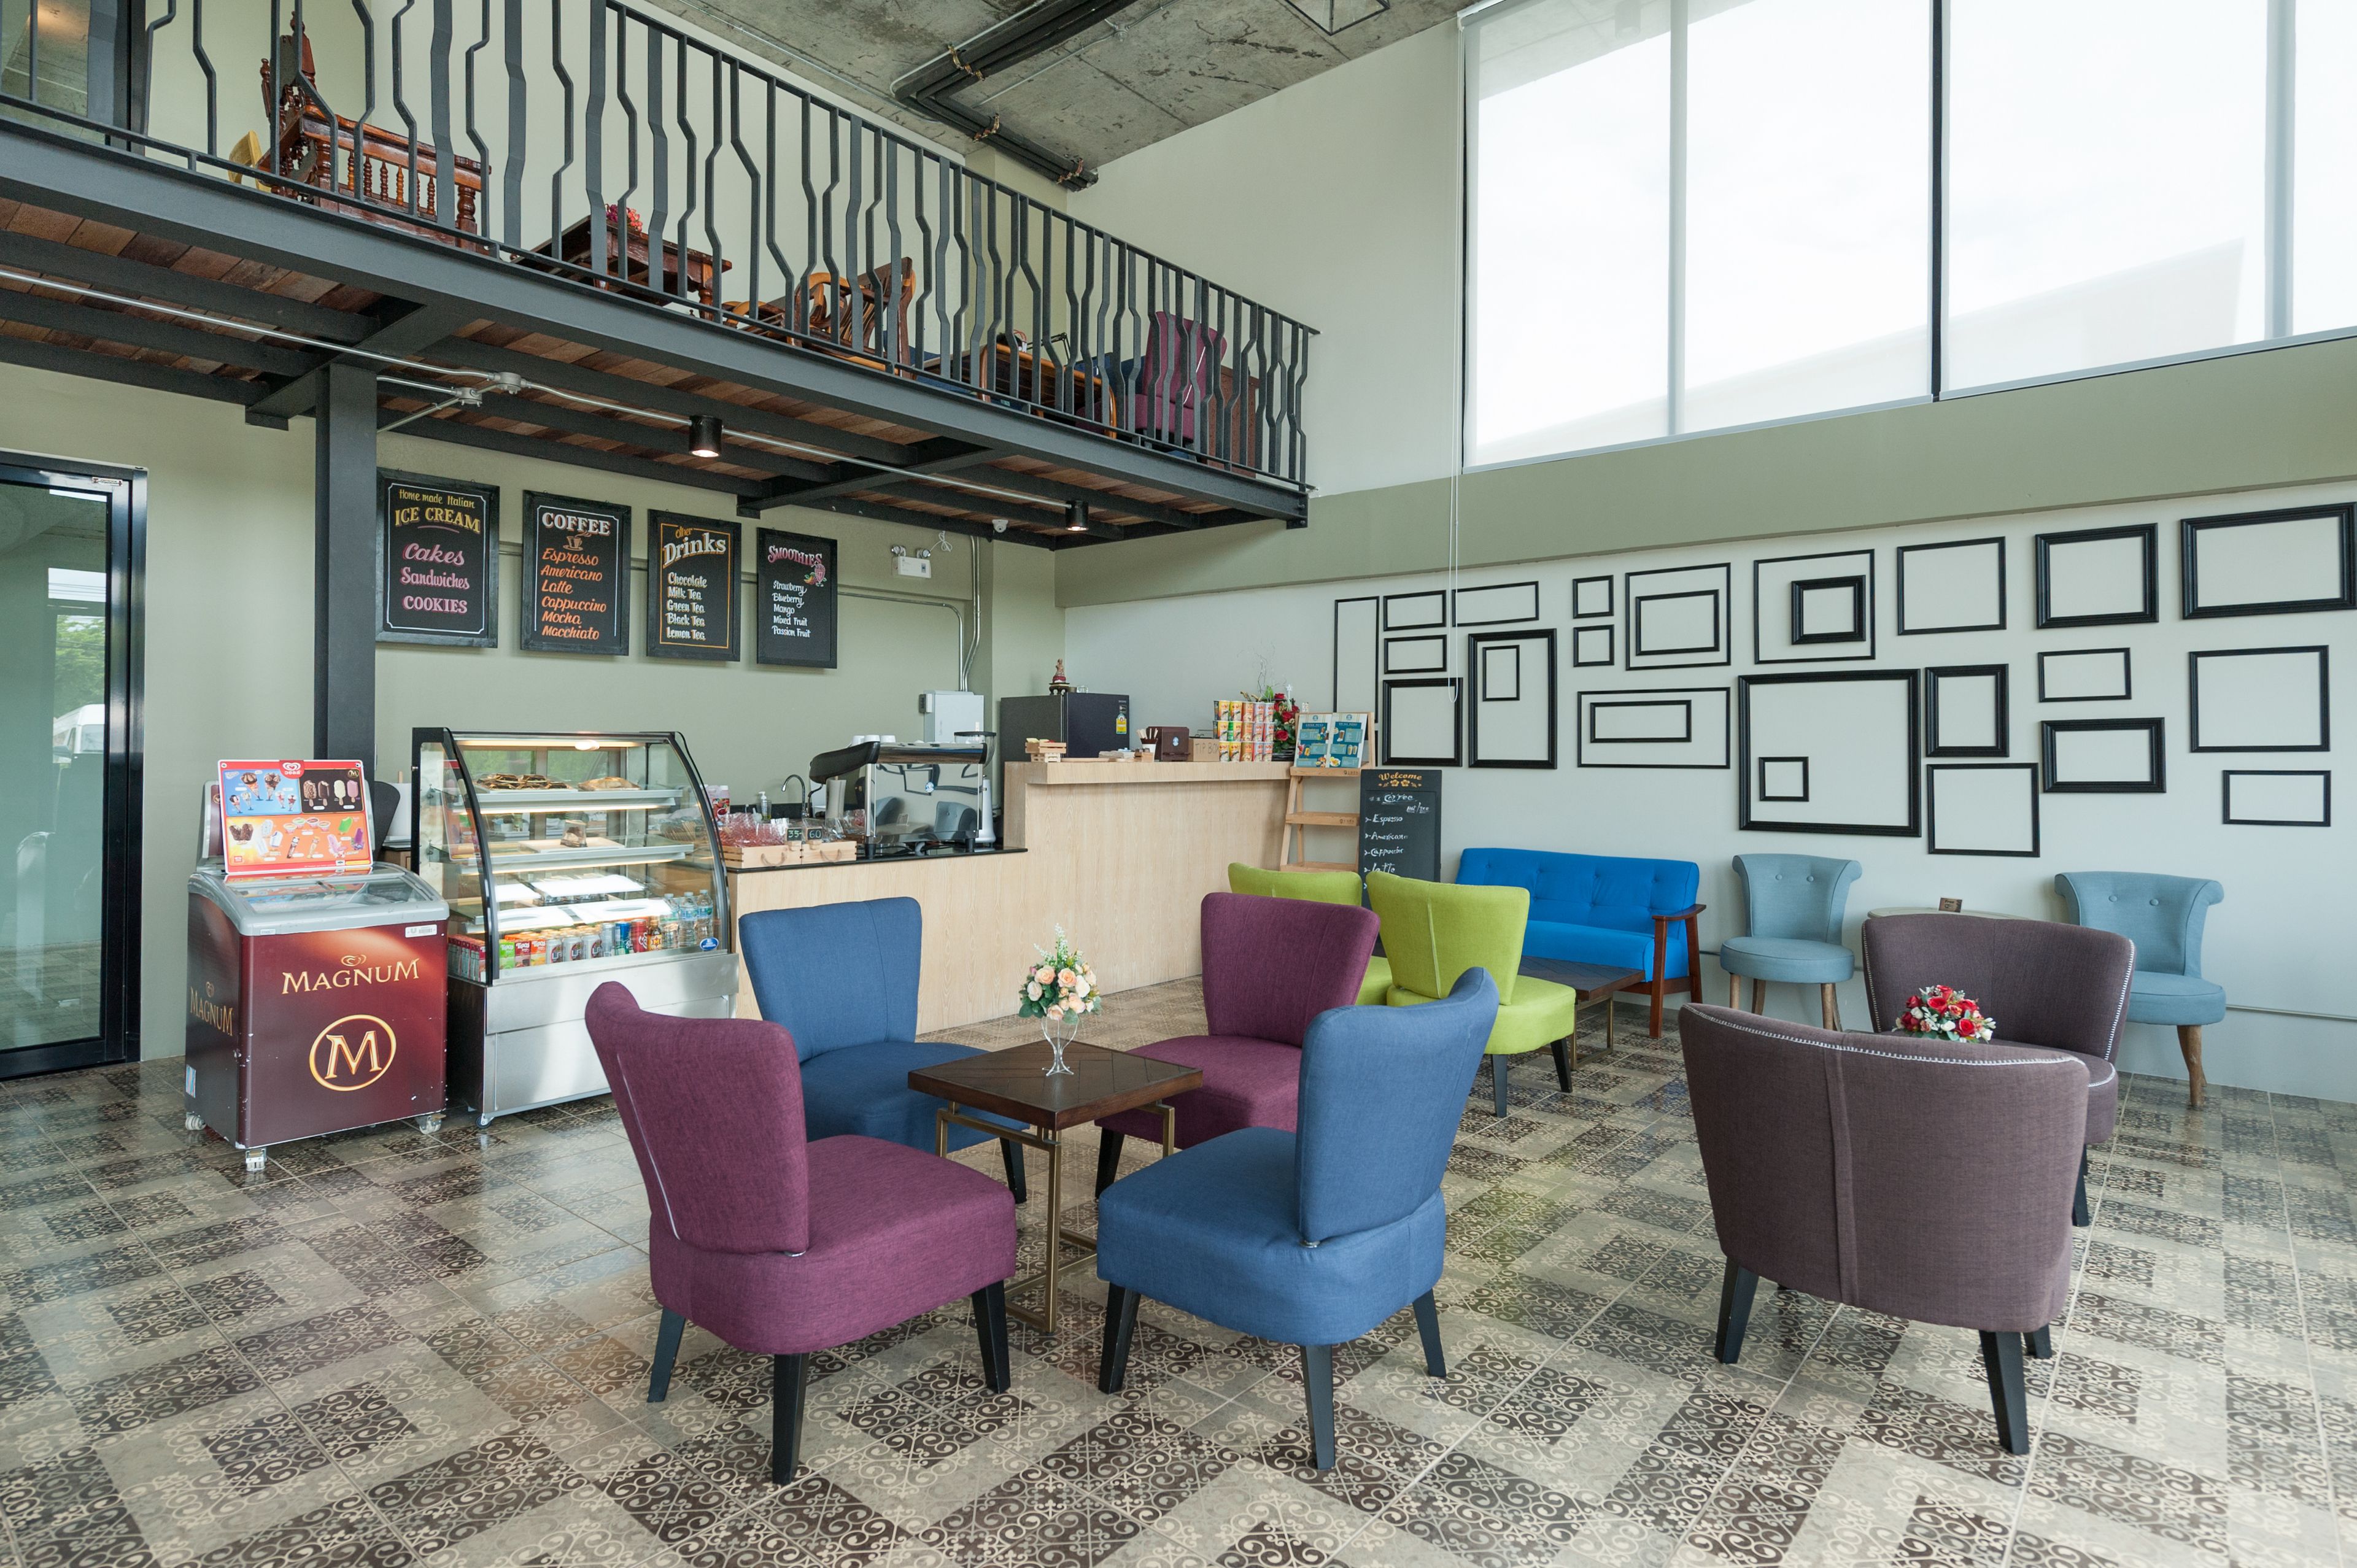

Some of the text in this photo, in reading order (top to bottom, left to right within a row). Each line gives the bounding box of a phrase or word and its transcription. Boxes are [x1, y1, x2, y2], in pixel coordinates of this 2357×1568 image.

[399, 489, 475, 509] Home made Italian
[395, 507, 481, 534] ICE CREAM
[542, 512, 611, 536] COFFEE
[675, 526, 692, 538] other
[403, 543, 465, 566] Cakes
[541, 548, 599, 566] Espresso
[662, 533, 727, 569] Drinks
[768, 545, 822, 565] SMOOTHIES
[400, 567, 470, 590] Sandwiches
[541, 565, 603, 582] Americano
[668, 572, 707, 589] Chocolate
[541, 579, 573, 594] Latte
[667, 586, 702, 601] Milk Tea
[773, 580, 807, 597] Strawberry
[403, 595, 468, 614] COOKIES
[541, 596, 607, 612] Cappuccino
[667, 600, 705, 614] Green Tea
[772, 592, 805, 608] Blueberry
[541, 611, 582, 625] Mocha
[773, 603, 795, 617] Mango
[665, 612, 705, 627] Black Tea
[773, 615, 808, 627] Mixed Fruit
[541, 625, 600, 640] Macchiato
[666, 627, 706, 641] Lemon Tea
[772, 625, 811, 638] Passion Fruit
[1195, 743, 1206, 754] TIP
[1379, 772, 1422, 781] Welcome
[809, 830, 821, 838] 60
[281, 958, 420, 994] MAGNUM
[190, 986, 234, 1037] MAGNUM
[324, 1030, 382, 1079] M
